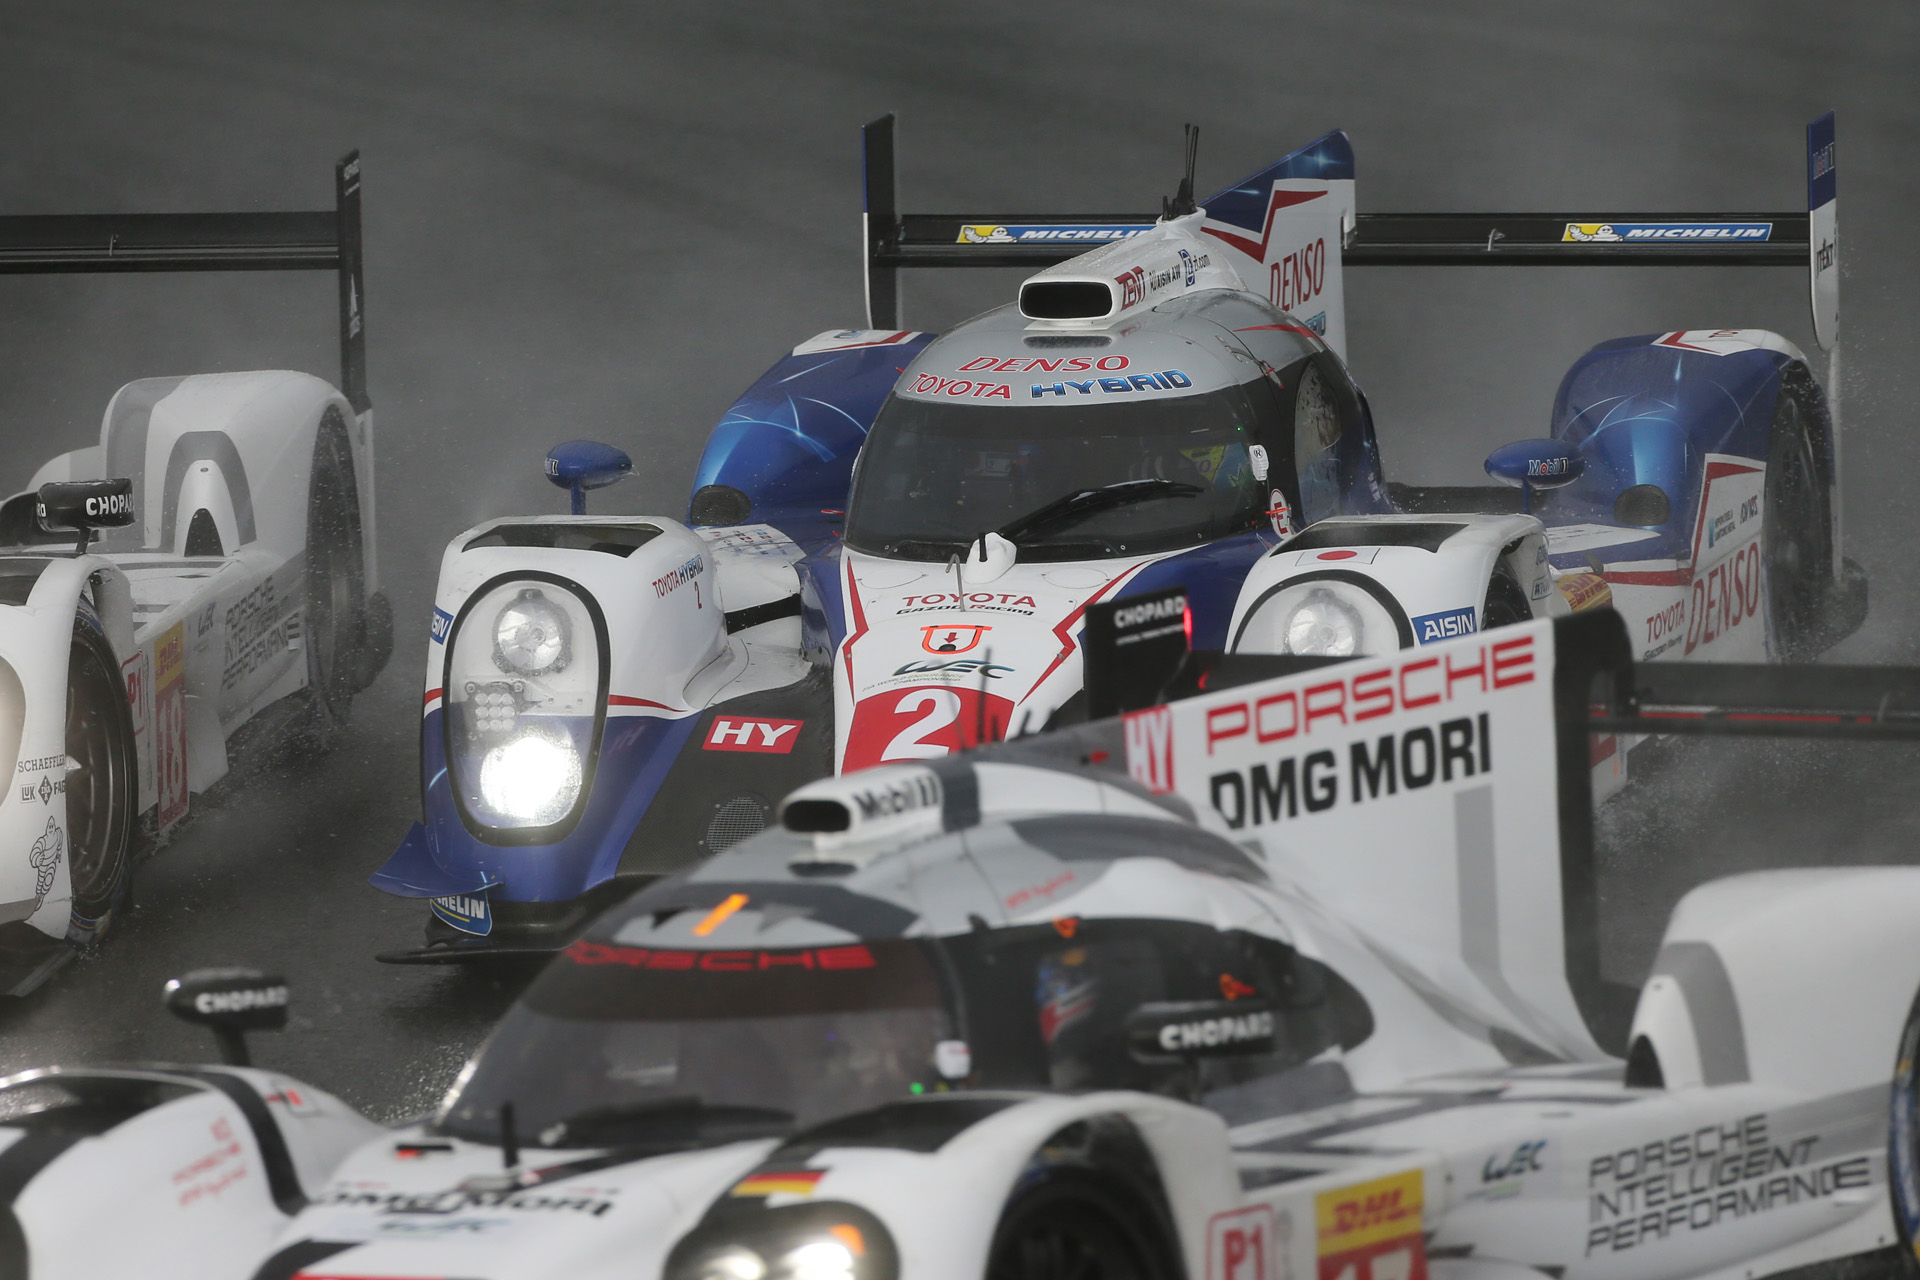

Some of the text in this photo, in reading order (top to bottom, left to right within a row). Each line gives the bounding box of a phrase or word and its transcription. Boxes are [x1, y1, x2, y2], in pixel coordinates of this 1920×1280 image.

[1019, 230, 1150, 240] MICHELI
[1627, 228, 1768, 238] MICHELIN
[1270, 238, 1325, 311] DENSO
[956, 355, 1131, 373] DENSO
[907, 369, 1193, 399] TOYOTA HYBRID
[652, 554, 703, 598] TOYOTA HYBRID
[902, 593, 1036, 607] TOYOTA
[969, 604, 1034, 616] Racing
[1114, 595, 1186, 629] CHOPARD
[1684, 542, 1760, 657] DENSO
[1424, 613, 1474, 641] AISIN
[1646, 599, 1684, 644] TOYOTA
[893, 660, 1015, 679] WEC
[1206, 636, 1535, 756] PORSCHE
[710, 721, 798, 746] HY
[880, 688, 962, 762] 2
[158, 689, 184, 812] 18
[1126, 707, 1172, 792] HY
[1211, 712, 1492, 829] DMG MORI
[437, 895, 485, 919] HELIN
[566, 941, 876, 970] PORSCHE
[196, 986, 289, 1013] CHOPARD
[1159, 1012, 1273, 1049] CHOPARD
[1590, 1114, 1768, 1188] PORSCHE
[1590, 1136, 1820, 1222] INTELLIGENT
[1586, 1157, 1871, 1257] PERFORMANCE
